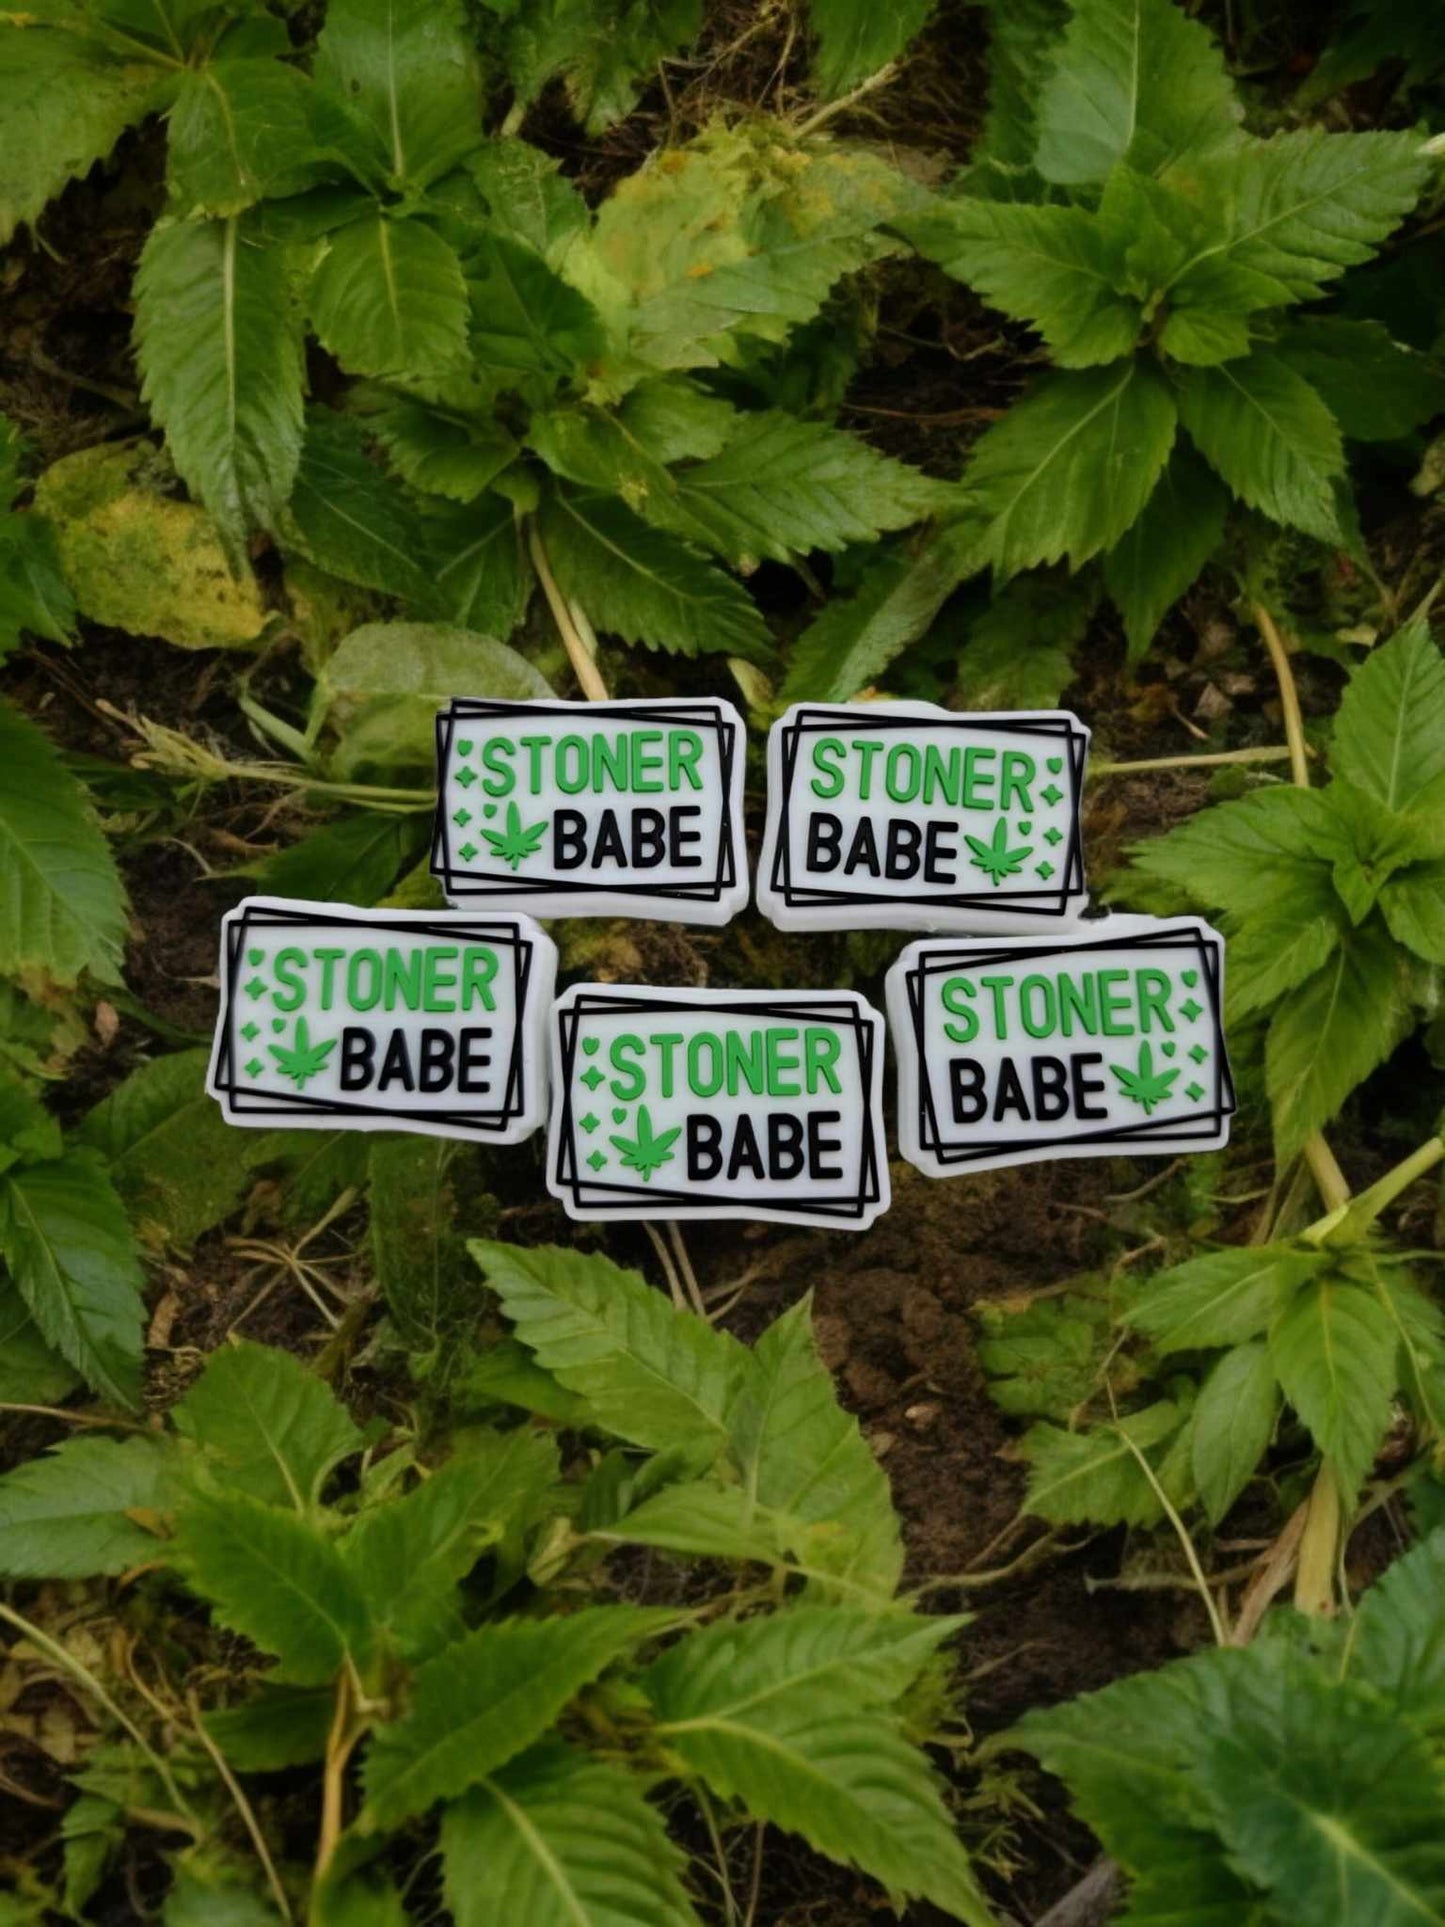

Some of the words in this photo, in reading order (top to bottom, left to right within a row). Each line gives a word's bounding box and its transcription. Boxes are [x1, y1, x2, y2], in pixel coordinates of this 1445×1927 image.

[481, 729, 703, 797] STONER
[810, 737, 1036, 813] STONER
[553, 805, 701, 870] BABE
[805, 811, 958, 884] BABE
[271, 946, 499, 1013] STONER
[941, 968, 1174, 1043] STONER
[339, 1026, 492, 1093] BABE
[609, 1027, 841, 1101] STONER
[948, 1052, 1108, 1124] BABE
[686, 1110, 843, 1181] BABE
